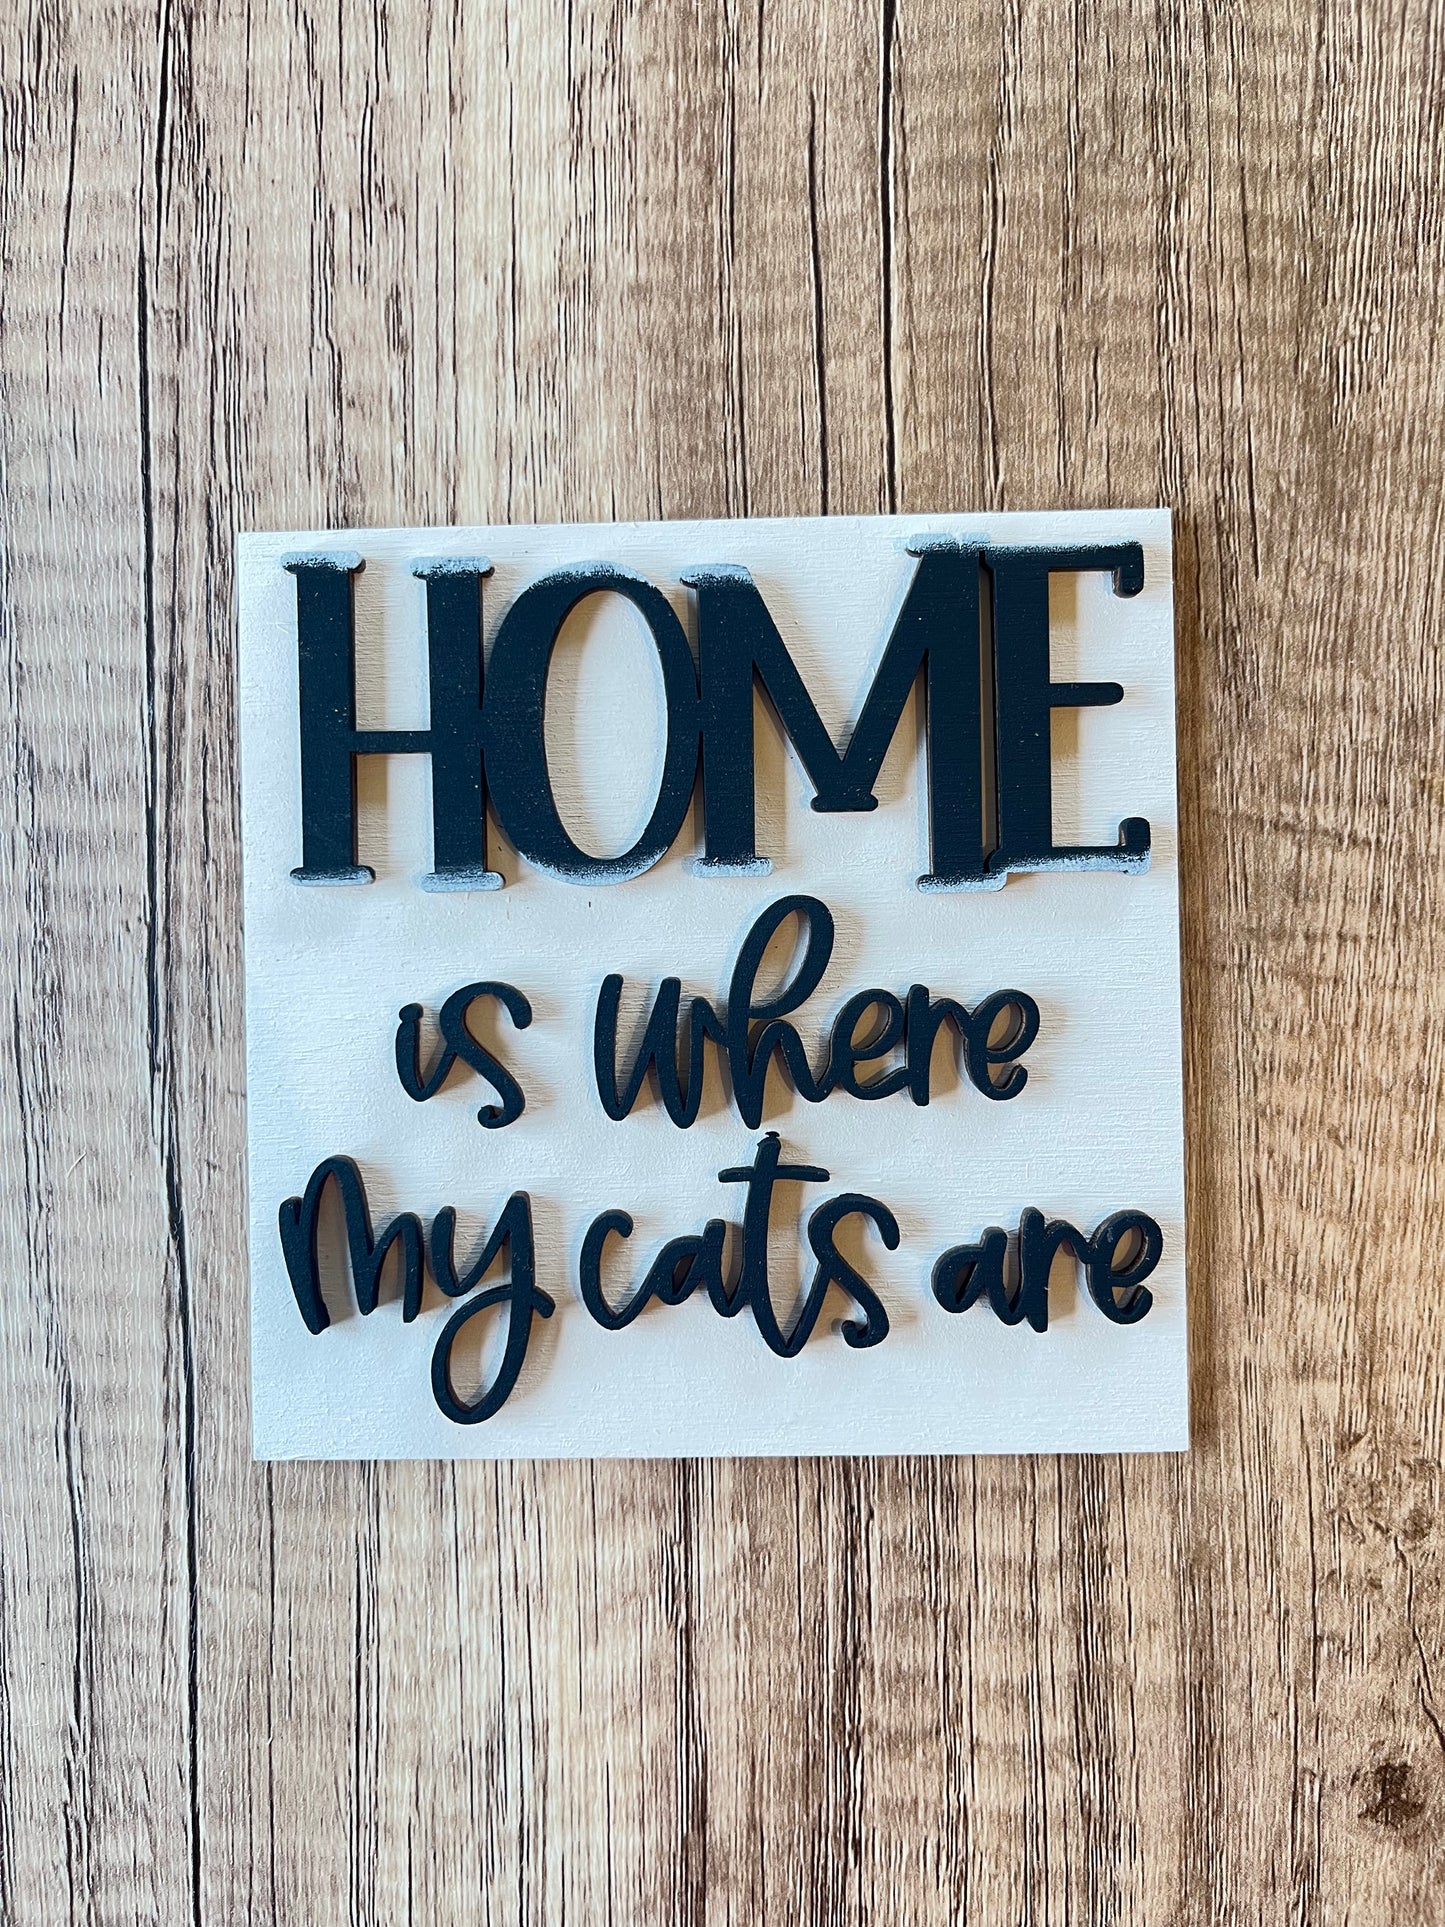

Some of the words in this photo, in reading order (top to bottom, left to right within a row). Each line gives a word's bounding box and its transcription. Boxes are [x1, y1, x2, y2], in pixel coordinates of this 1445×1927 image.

[282, 535, 1151, 892] HOME
[395, 980, 533, 1130] is
[594, 894, 1041, 1131] where
[580, 1131, 901, 1359] cats
[932, 1206, 1163, 1333] are
